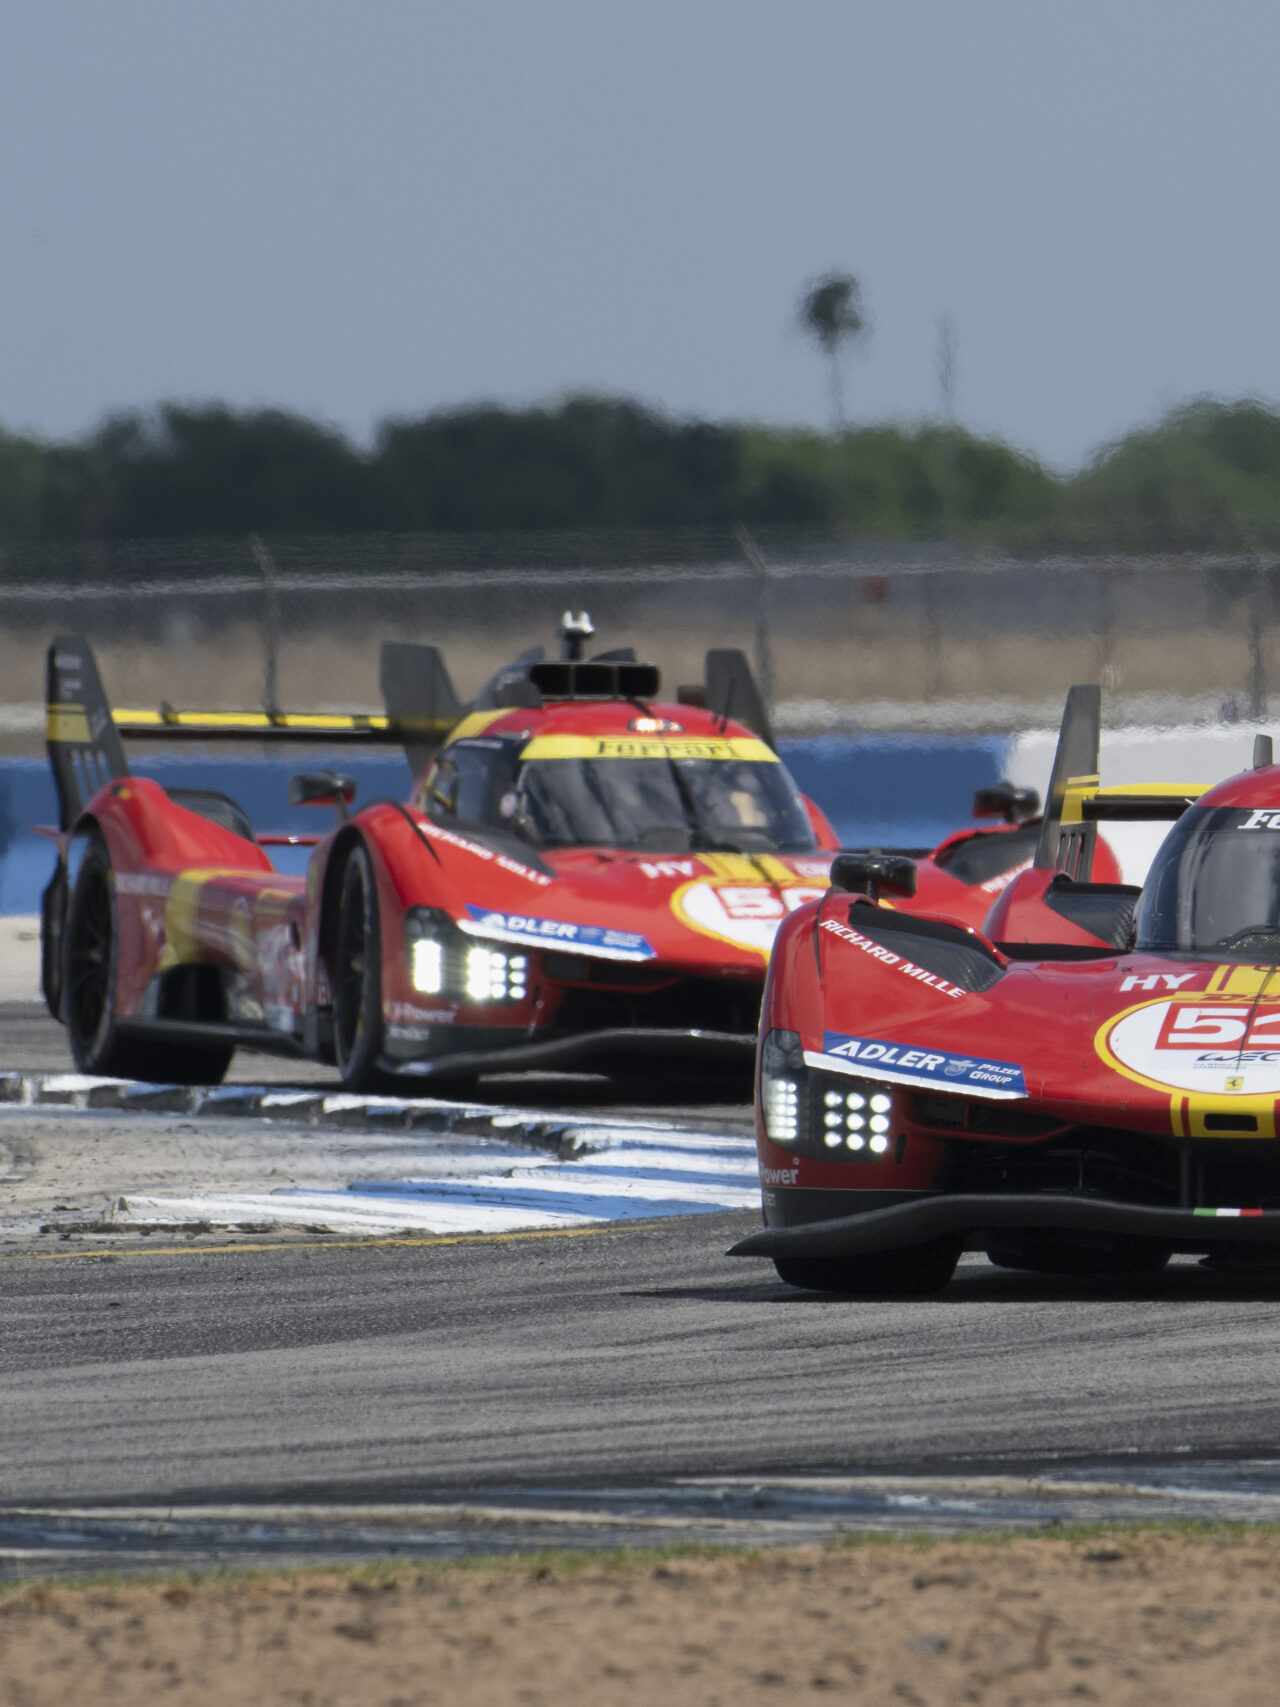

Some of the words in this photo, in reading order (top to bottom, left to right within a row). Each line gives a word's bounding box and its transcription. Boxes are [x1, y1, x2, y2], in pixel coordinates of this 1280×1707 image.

[480, 912, 578, 939] ADLER
[819, 919, 900, 965] RICHARD
[898, 962, 967, 998] MILLE
[1119, 973, 1197, 992] HY
[827, 1041, 946, 1071] ADLER
